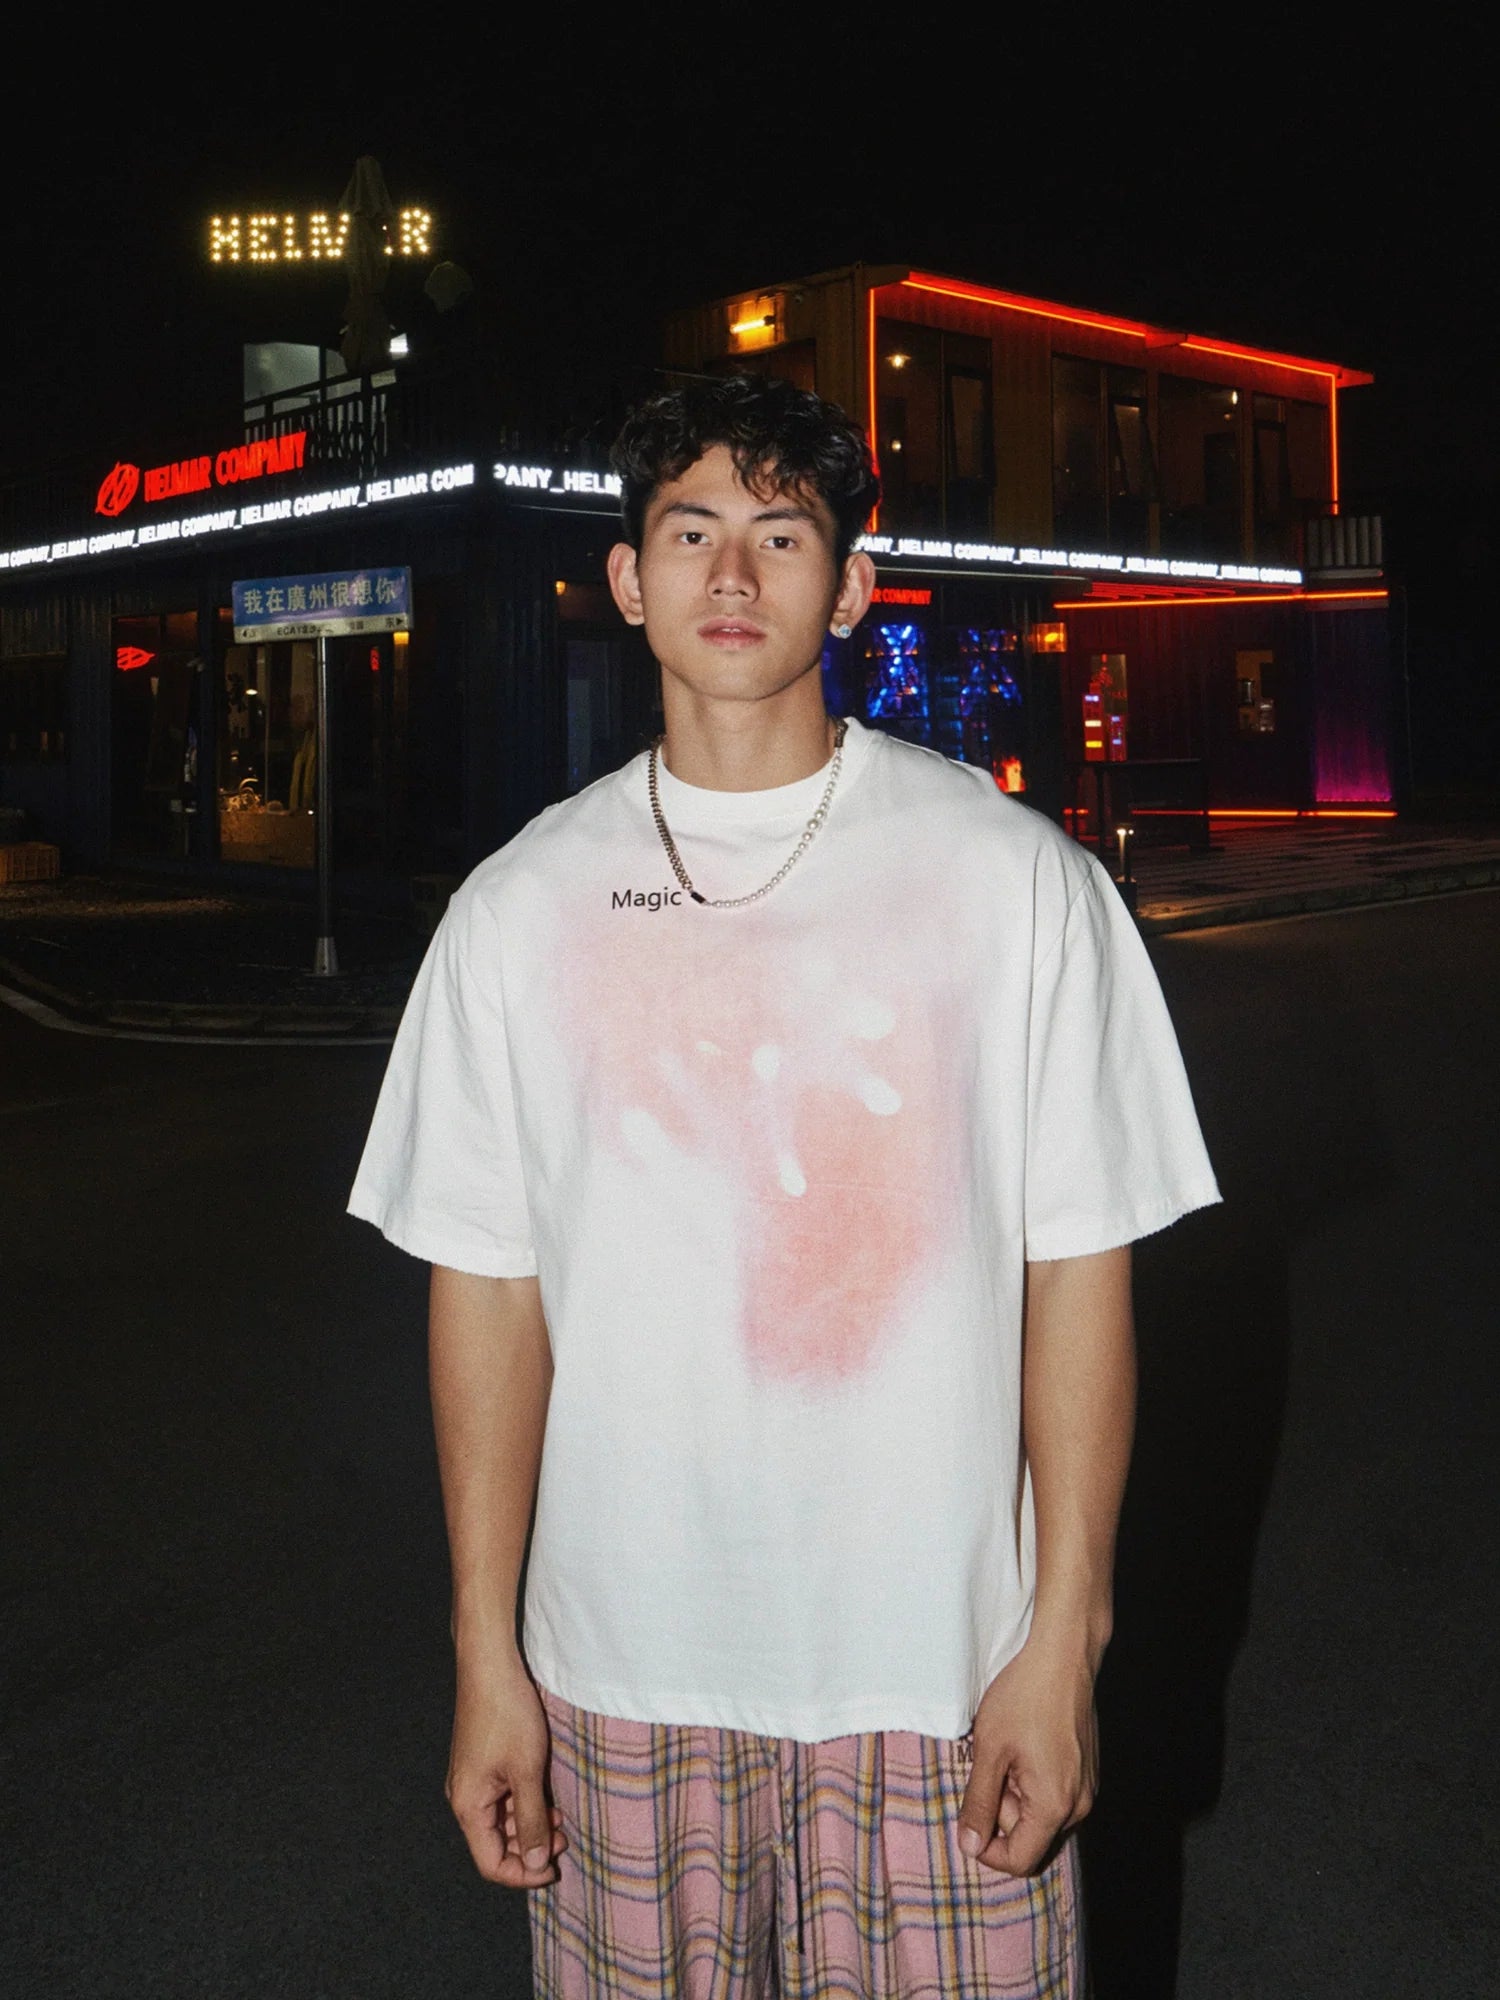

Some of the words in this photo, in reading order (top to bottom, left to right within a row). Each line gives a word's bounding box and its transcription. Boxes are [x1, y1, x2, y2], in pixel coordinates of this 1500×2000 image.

[210, 210, 432, 262] HELMR
[144, 456, 212, 502] HELMAR
[215, 431, 307, 486] COMPANY
[244, 576, 398, 614] 我在廣州很想你
[882, 588, 932, 605] COMPANY
[612, 886, 682, 912] Magic
